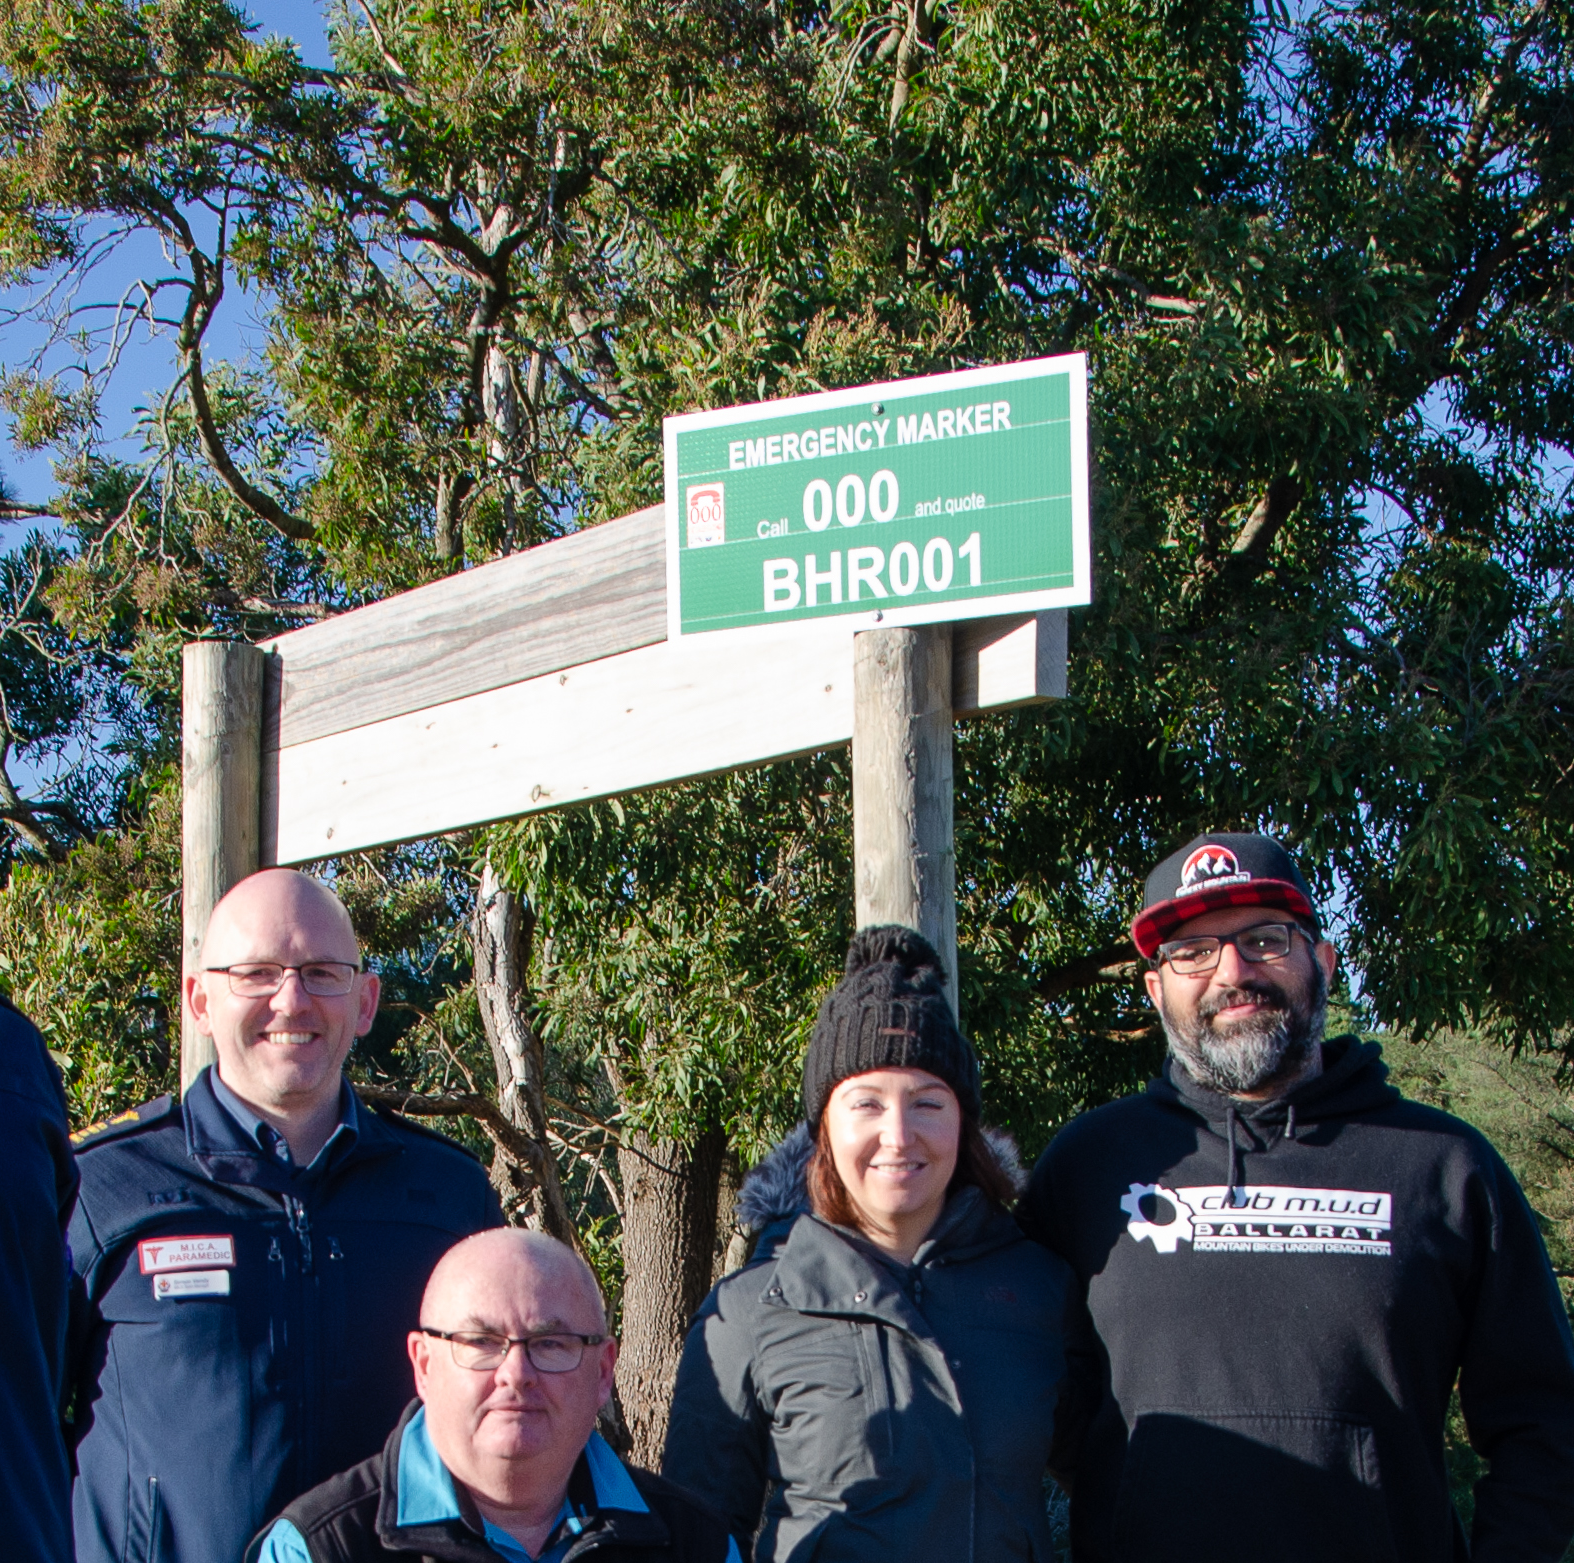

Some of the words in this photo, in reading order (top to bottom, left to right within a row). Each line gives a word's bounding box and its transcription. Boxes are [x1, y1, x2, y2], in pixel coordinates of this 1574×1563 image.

[728, 420, 891, 470] EMERGENCY
[897, 402, 1011, 445] MARKER
[757, 518, 789, 538] Call
[803, 469, 899, 532] 000
[915, 496, 941, 517] and
[945, 492, 985, 516] quote
[763, 532, 982, 612] BHR001
[1284, 1198, 1382, 1216] m.u.d
[1194, 1222, 1383, 1241] BALLARAT
[169, 1251, 231, 1263] PARAMEDIC
[1193, 1241, 1252, 1252] MOUNTAIN
[1253, 1241, 1284, 1252] BIKES
[1285, 1242, 1323, 1253] UNDER
[1324, 1243, 1392, 1257] DEMOLITION
